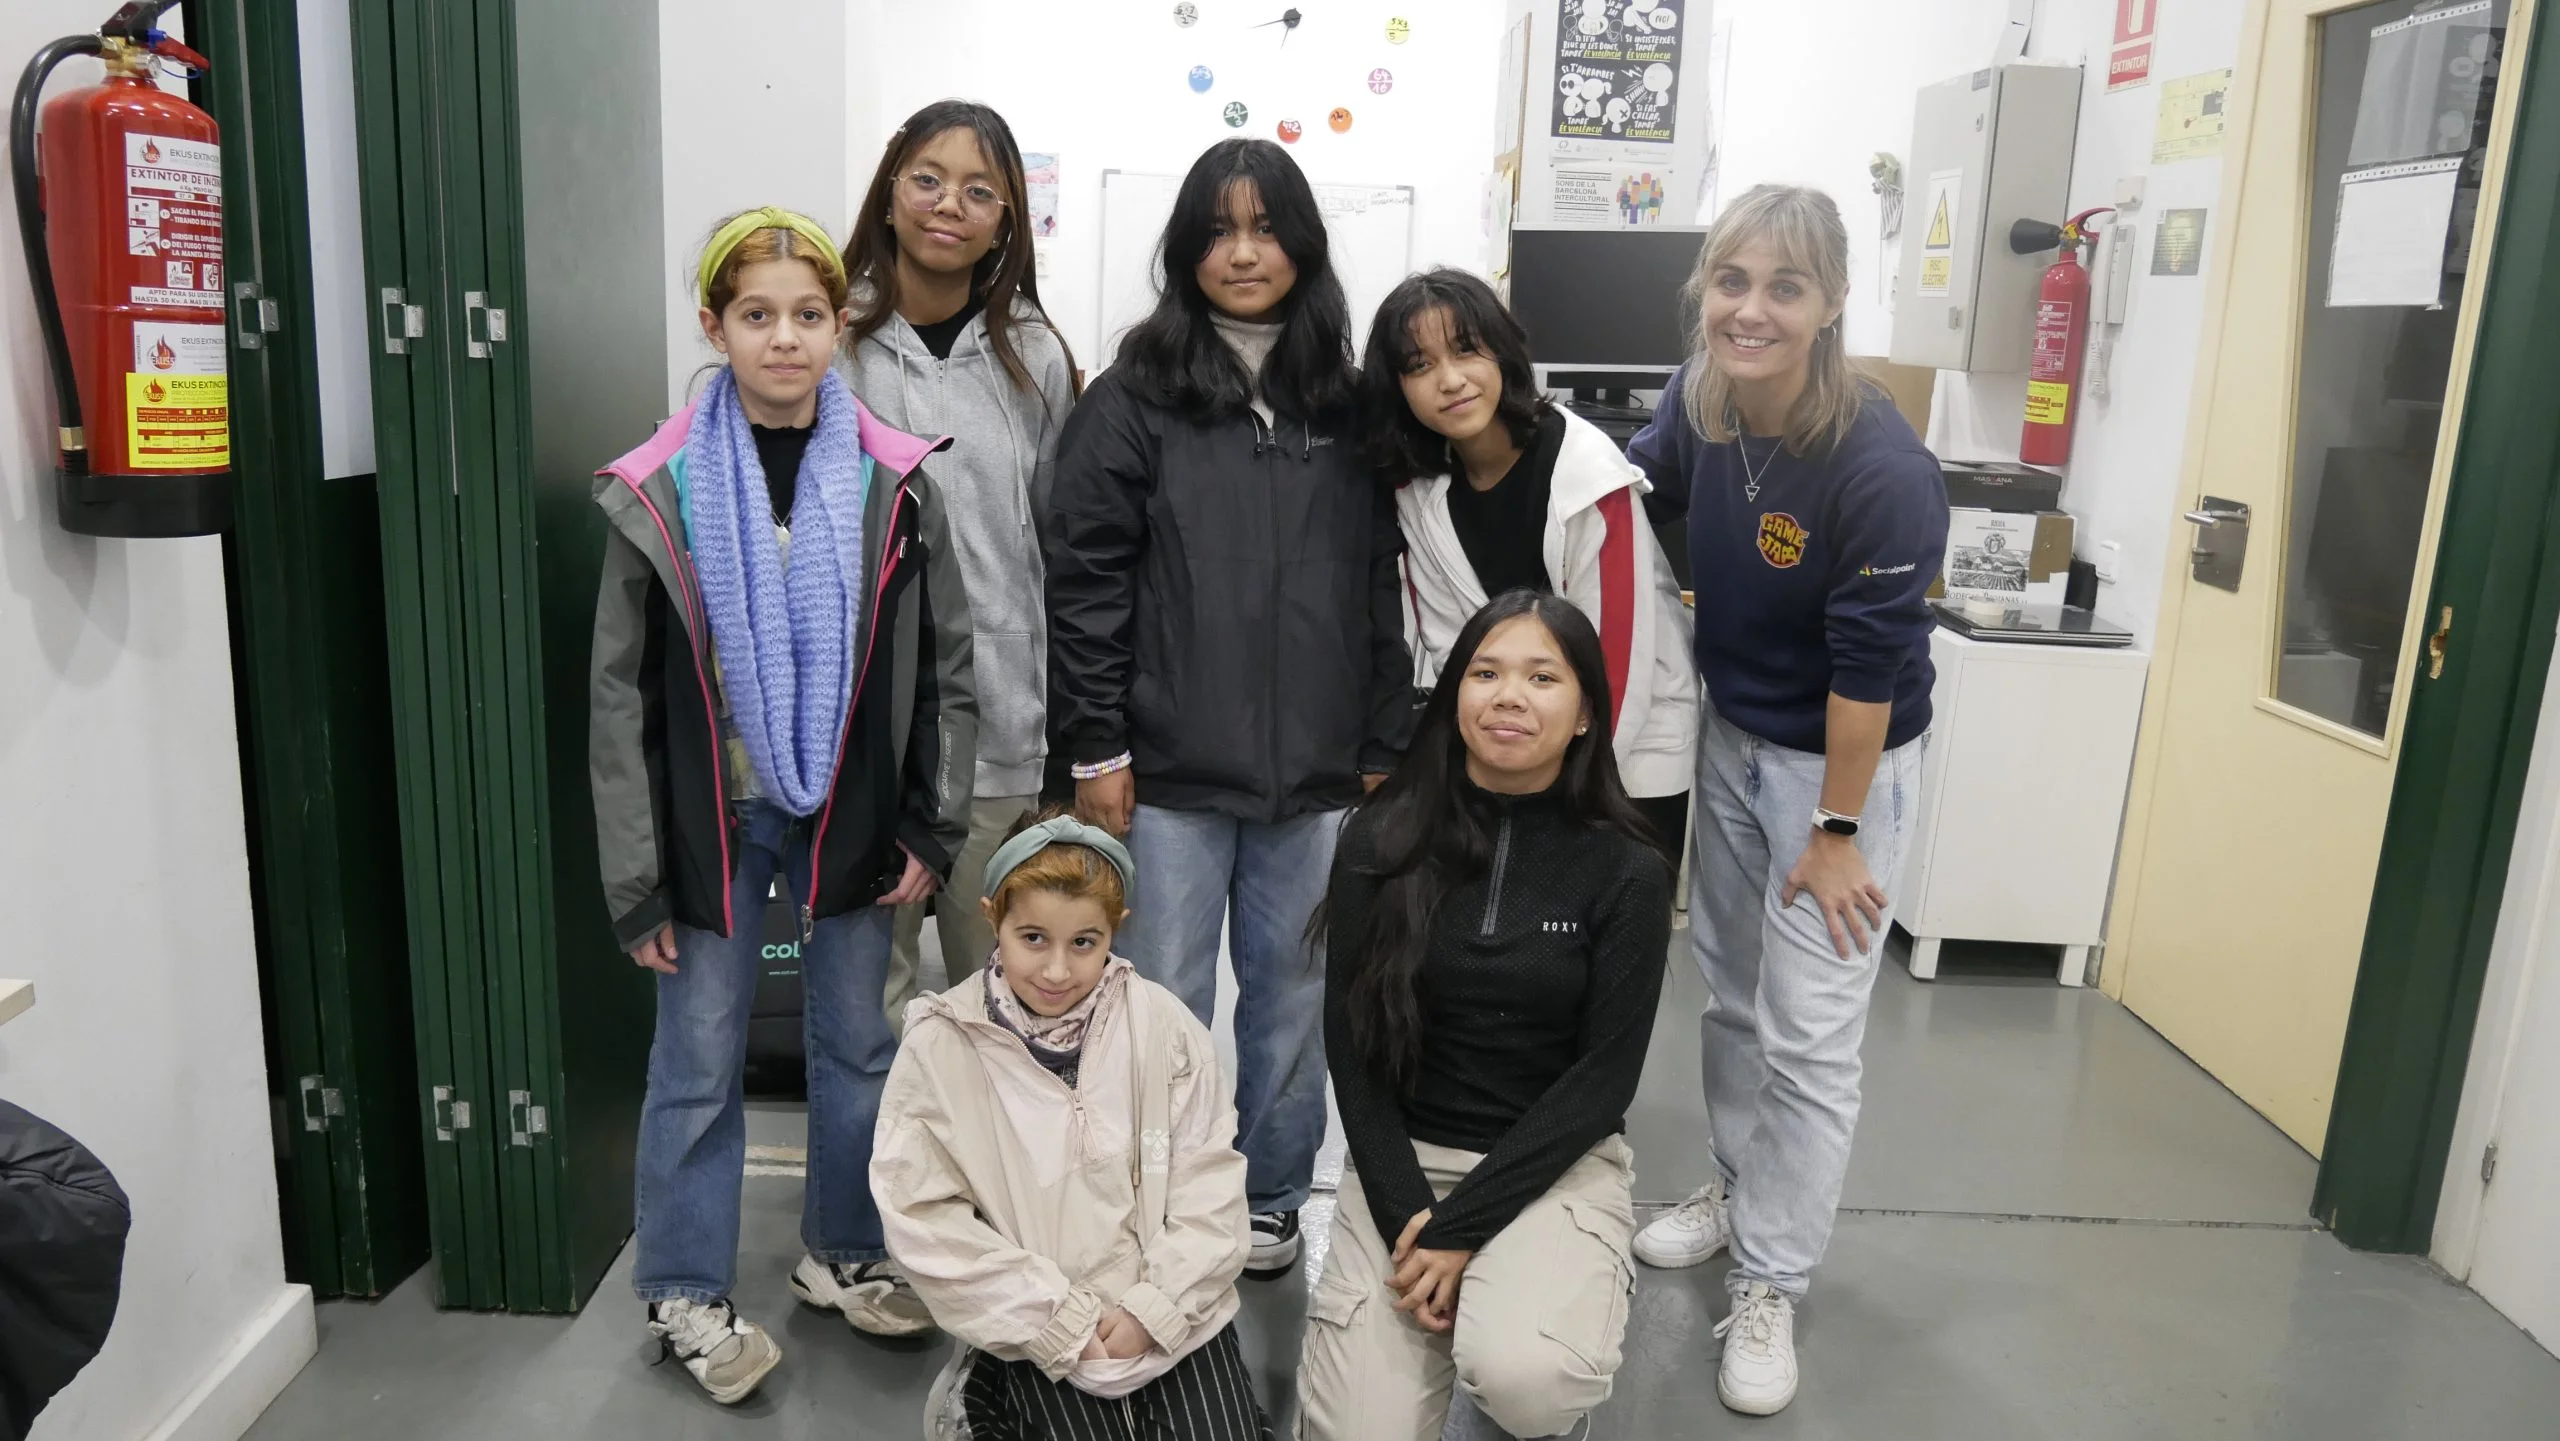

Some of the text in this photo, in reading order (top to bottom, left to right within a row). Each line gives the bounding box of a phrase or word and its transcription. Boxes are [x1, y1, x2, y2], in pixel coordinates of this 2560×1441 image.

[2111, 55, 2148, 74] EXTINTOR
[170, 149, 192, 159] EKUS
[131, 168, 188, 183] EXTINTOR
[191, 175, 202, 185] DE
[175, 217, 199, 225] TIRANDO
[184, 242, 202, 250] FUEGO
[172, 381, 197, 389] EKUS
[1761, 513, 1810, 548] GAME
[1759, 533, 1800, 564] JAM
[1872, 563, 1916, 576] Socialpoint
[1543, 921, 1578, 933] ROXY
